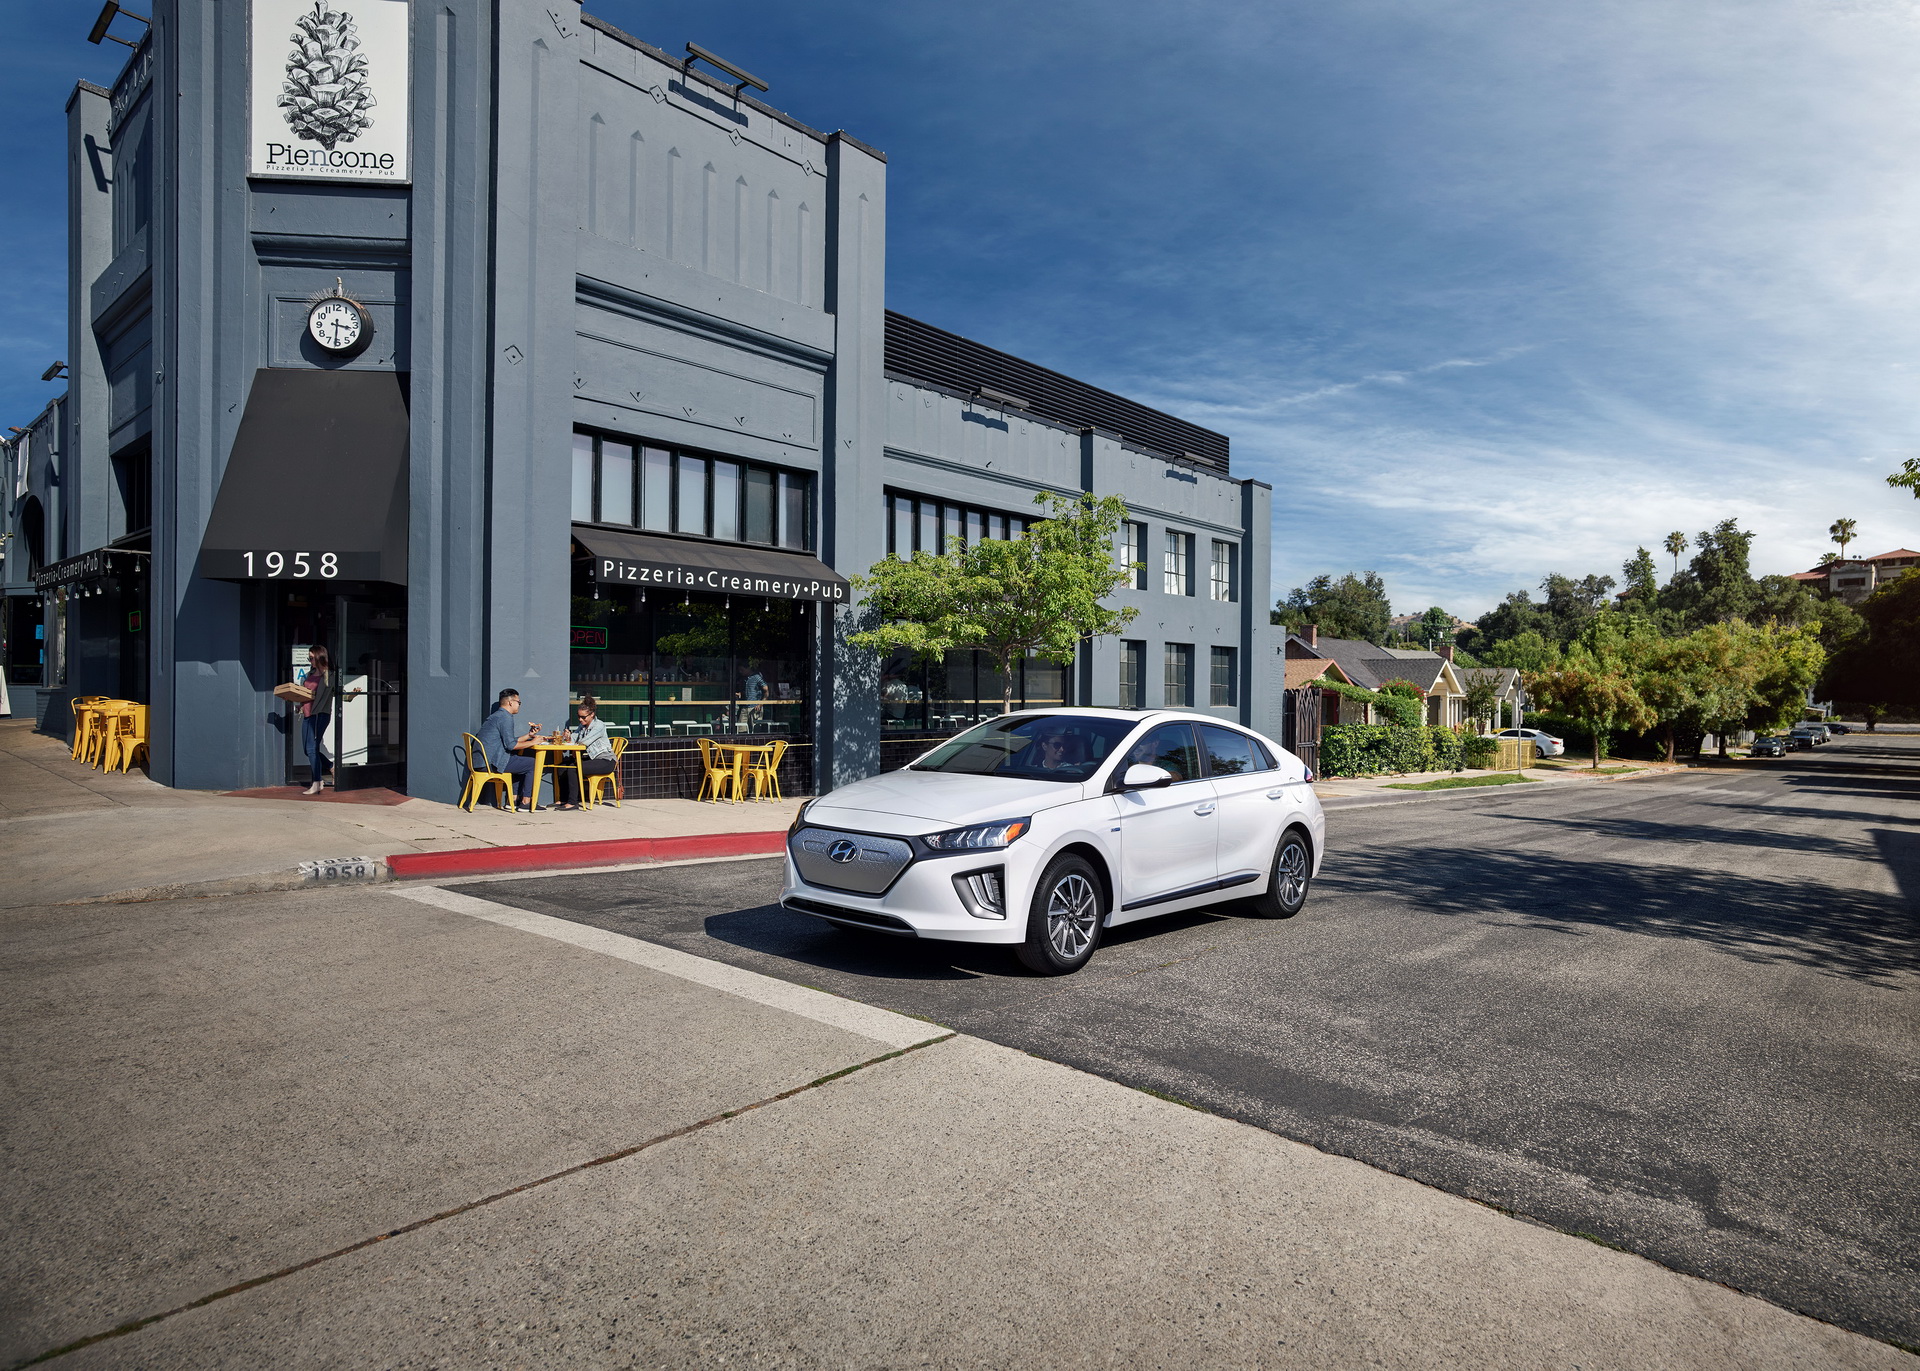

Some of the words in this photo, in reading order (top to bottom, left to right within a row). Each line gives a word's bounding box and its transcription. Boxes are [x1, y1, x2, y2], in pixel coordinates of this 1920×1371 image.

[266, 143, 394, 169] Piencone
[320, 167, 363, 175] Creamery
[325, 306, 331, 314] 11
[36, 567, 56, 587] Pizzeria
[57, 560, 84, 580] Creamery
[86, 552, 98, 572] Pub
[243, 551, 338, 578] 1958
[603, 560, 694, 585] Pizzeria
[707, 571, 801, 598] Creamery
[811, 581, 843, 599] Pub
[297, 668, 307, 680] A
[313, 865, 365, 881] 1958
